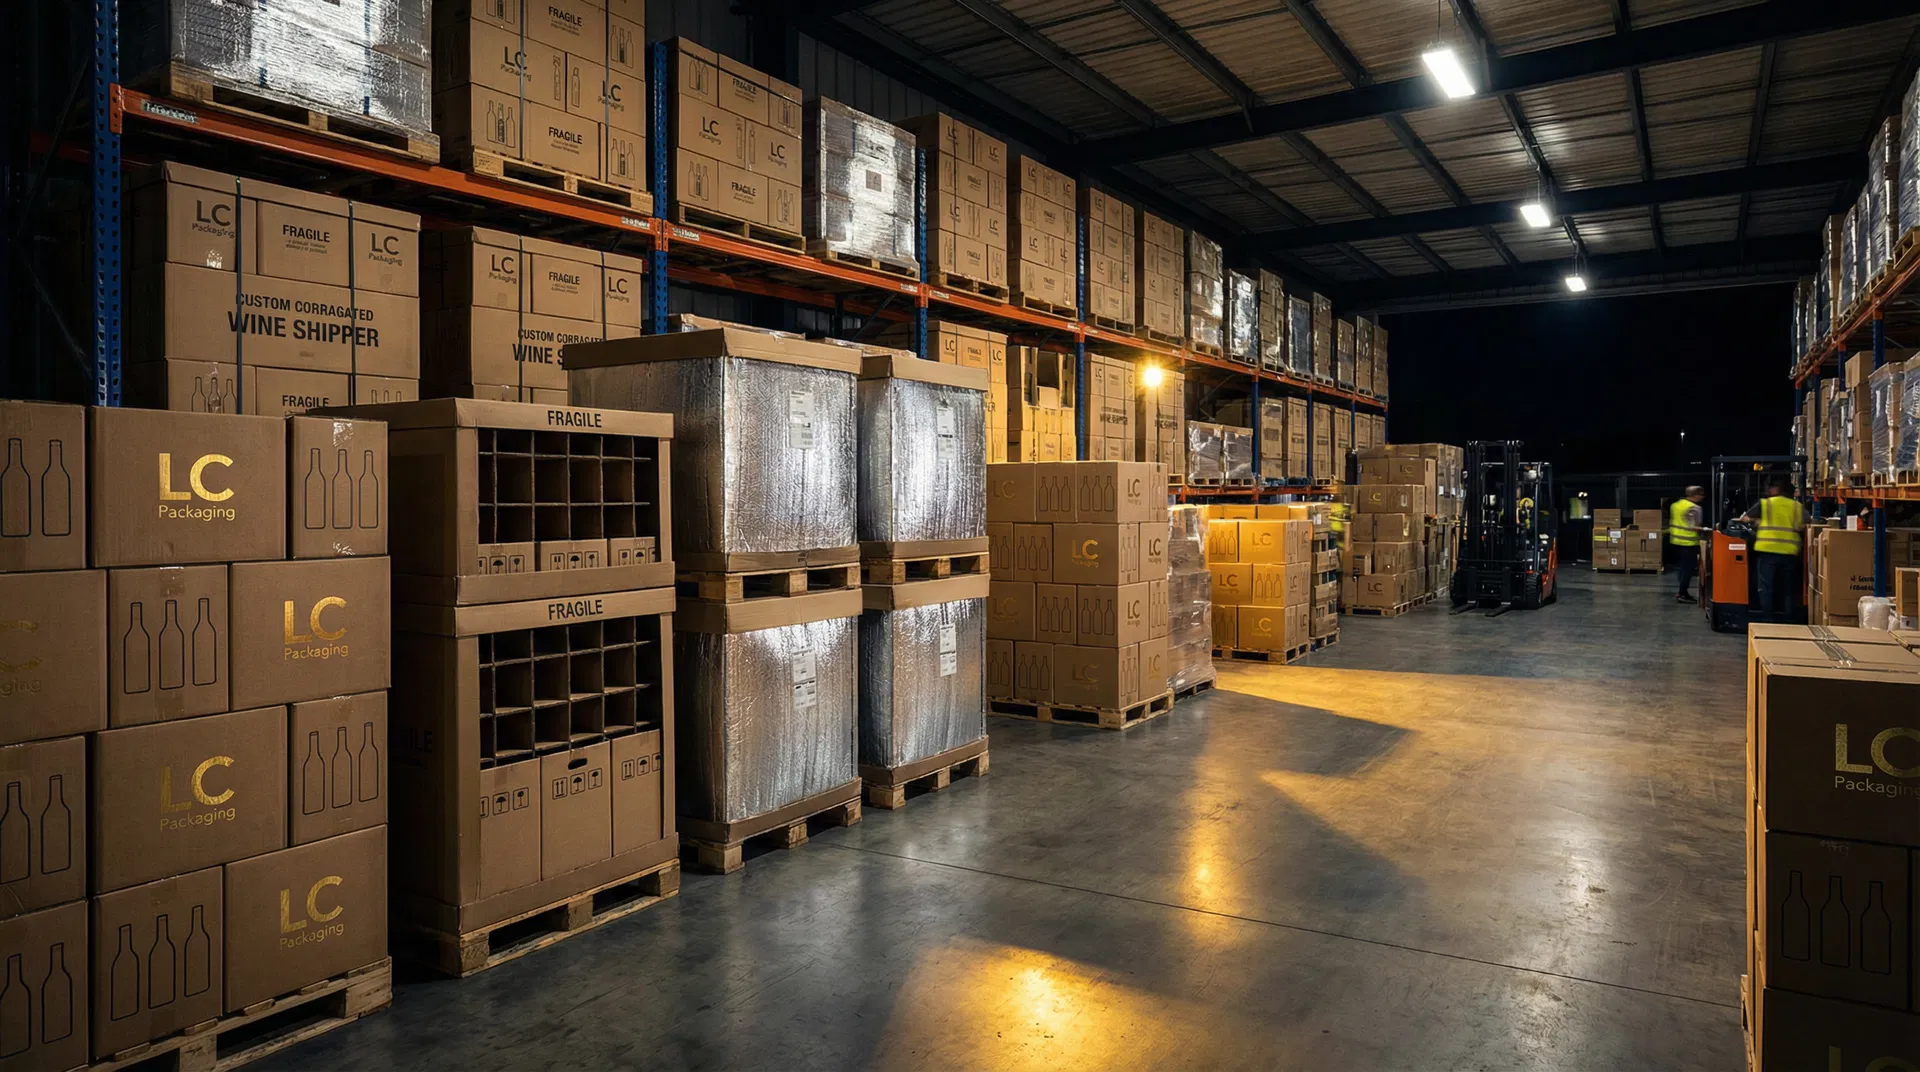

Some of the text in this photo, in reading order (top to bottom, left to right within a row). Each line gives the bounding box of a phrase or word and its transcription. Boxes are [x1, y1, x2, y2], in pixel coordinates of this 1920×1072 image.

[548, 6, 582, 27] FRAGILE
[504, 46, 527, 70] LC
[548, 126, 583, 145] FRAGILE
[702, 116, 719, 136] LC
[770, 141, 785, 159] LC
[197, 200, 231, 226] LC
[282, 224, 331, 243] FRAGILE
[371, 232, 400, 256] LC
[491, 254, 515, 274] LC
[548, 271, 580, 286] FRAGILE
[608, 276, 628, 294] LC
[235, 292, 375, 322] CUSTOM CORRAGATED
[227, 310, 380, 348] WINE SHIPPER
[517, 328, 555, 342] CUSTOM
[511, 343, 553, 365] WINE
[944, 338, 955, 352] LC
[992, 349, 1002, 361] LC
[281, 394, 330, 408] FRAGILE
[547, 410, 602, 428] FRAGILE
[158, 452, 235, 502] LC
[1128, 478, 1140, 497] LC
[158, 504, 236, 522] Packaging
[1149, 538, 1161, 556] LC
[1252, 533, 1272, 546] LC
[1072, 539, 1099, 560] LC
[1219, 574, 1238, 587] LC
[1367, 582, 1383, 593] LC
[548, 599, 604, 621] FRAGILE
[1127, 600, 1140, 620] LC
[284, 596, 347, 645] LC
[1252, 617, 1272, 632] LC
[284, 643, 349, 661] Packaging
[160, 755, 235, 813] LC
[159, 808, 236, 832] Packaging
[280, 875, 344, 934] LC
[279, 923, 344, 951] Packaging
